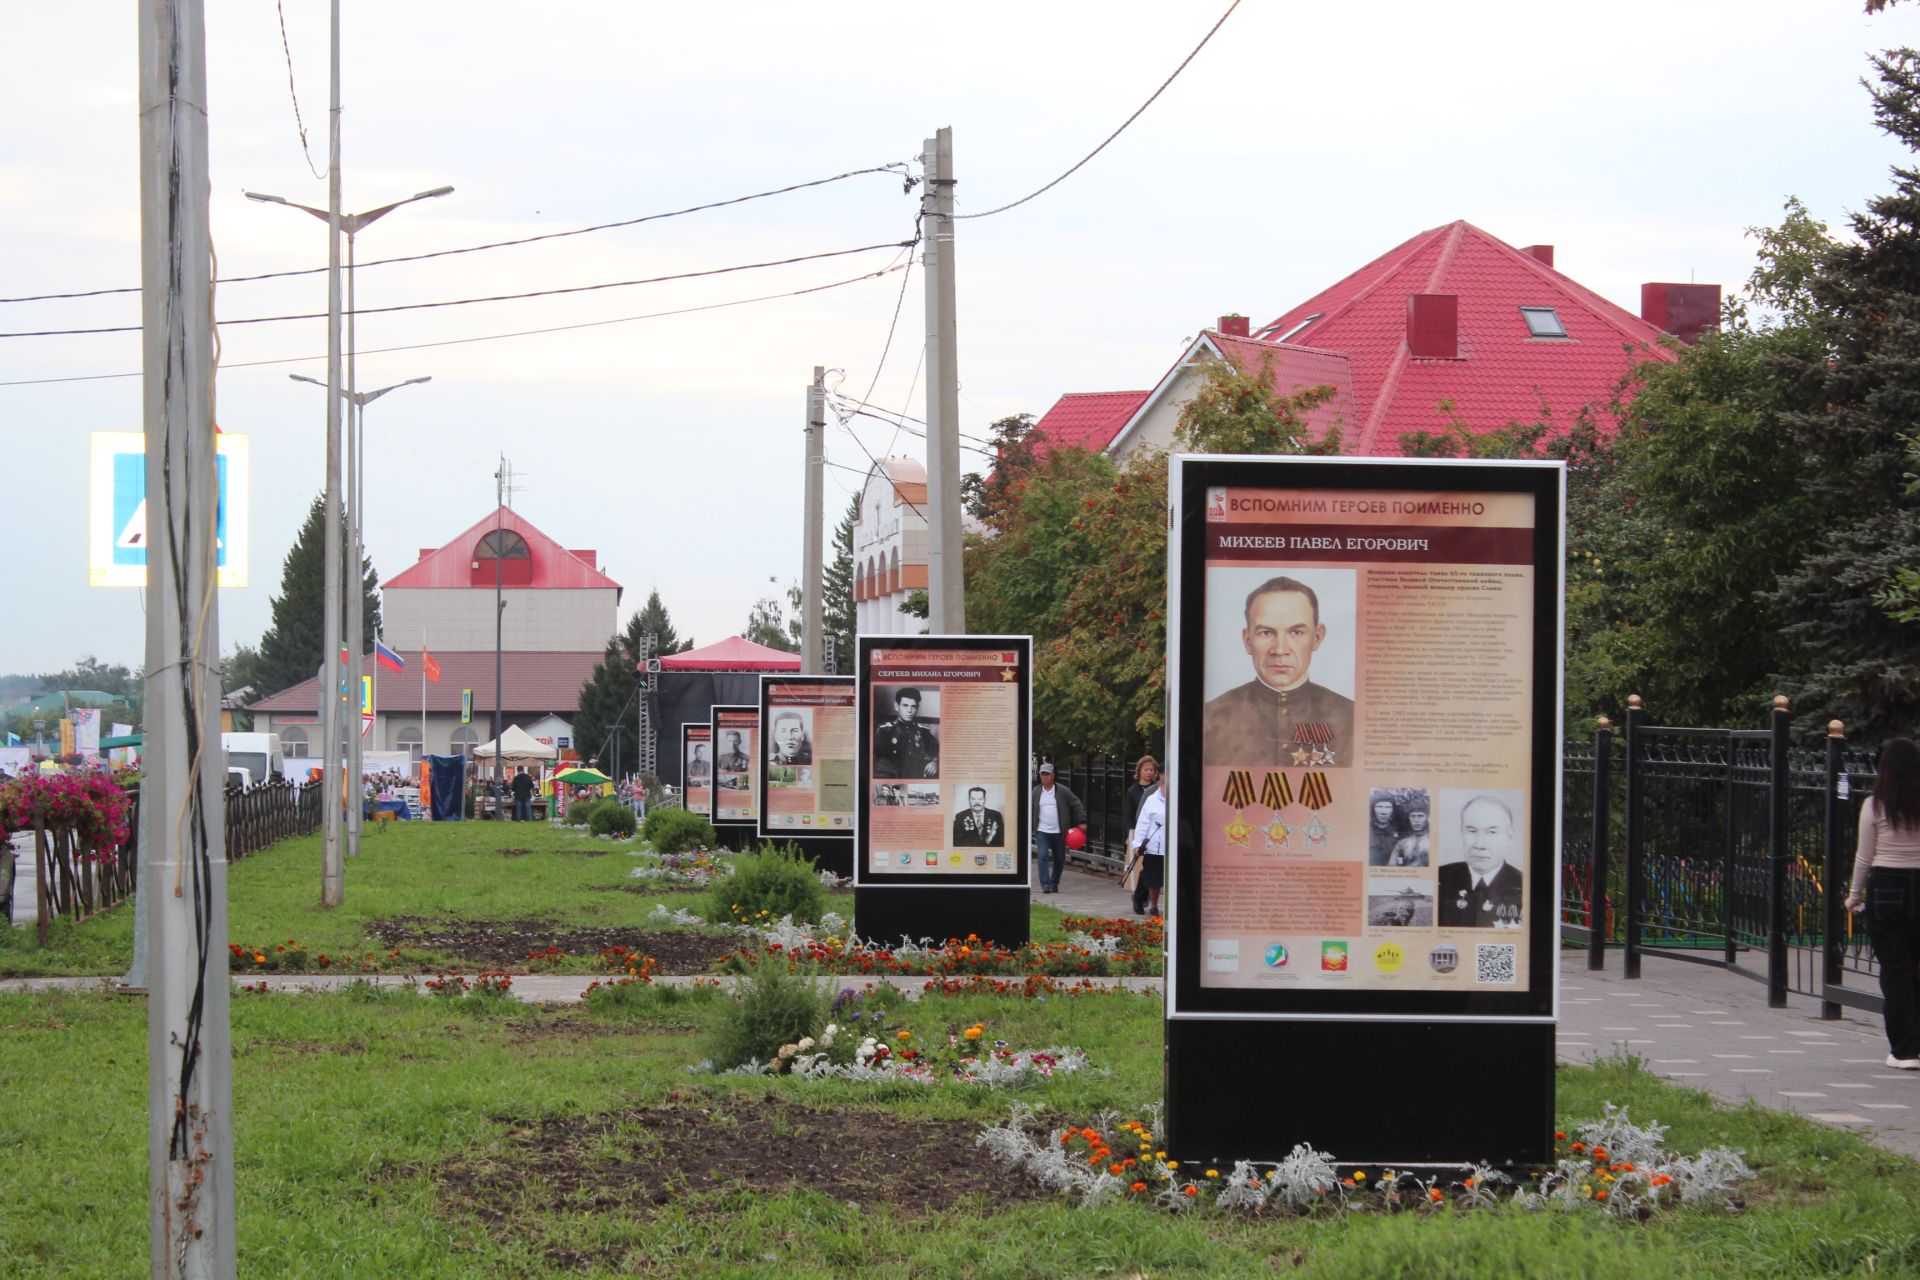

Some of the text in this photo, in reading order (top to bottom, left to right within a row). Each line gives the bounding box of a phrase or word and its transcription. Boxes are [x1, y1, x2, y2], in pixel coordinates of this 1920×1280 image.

[1230, 498, 1485, 515] ВСПОМНИМ ГЕРОЕВ ПОИМЕННО
[1219, 536, 1429, 551] МИХЕЕВ ПАВЕЛ ЕГОРОВИЧ
